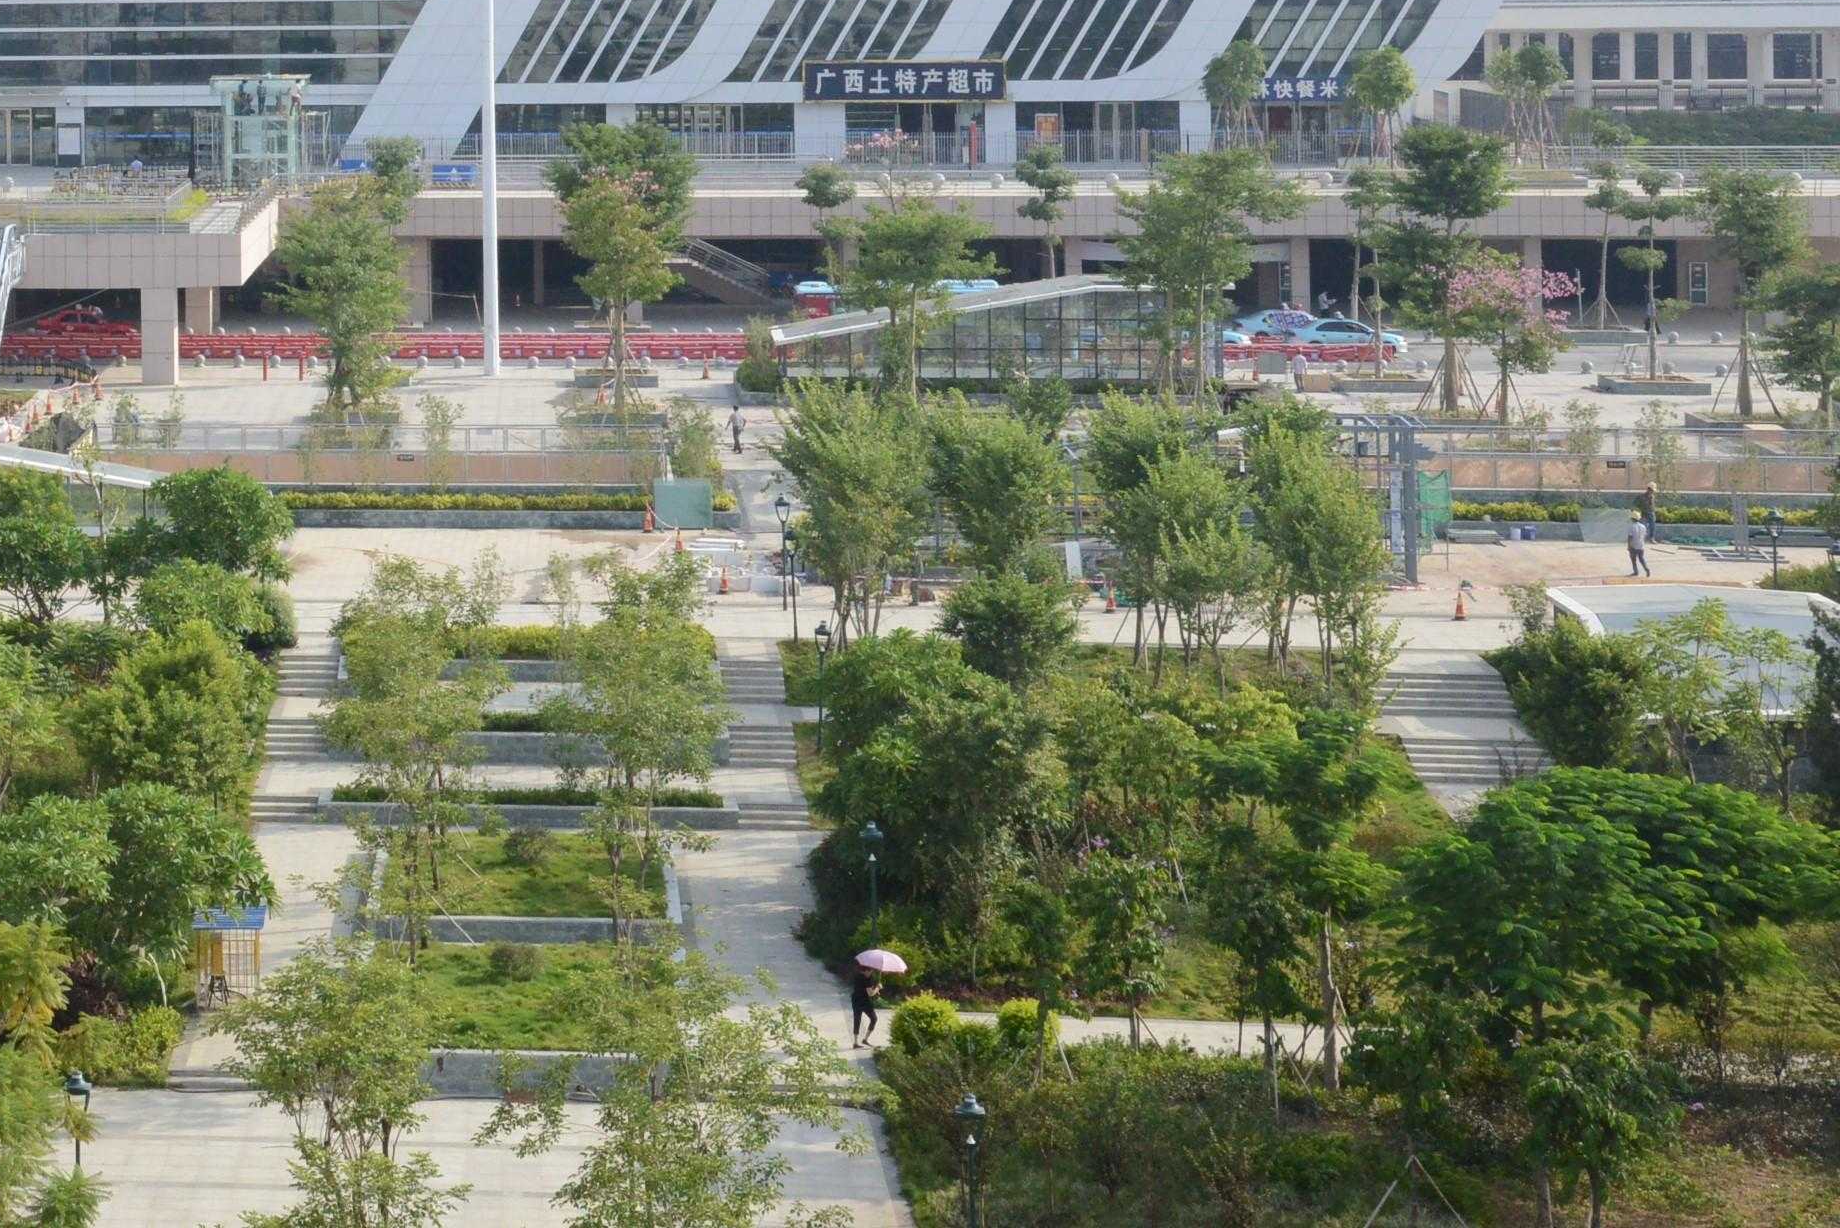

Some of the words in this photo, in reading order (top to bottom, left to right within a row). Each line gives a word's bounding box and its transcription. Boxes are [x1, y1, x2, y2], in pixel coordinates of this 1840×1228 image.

[815, 68, 995, 94] 广西土特产超市
